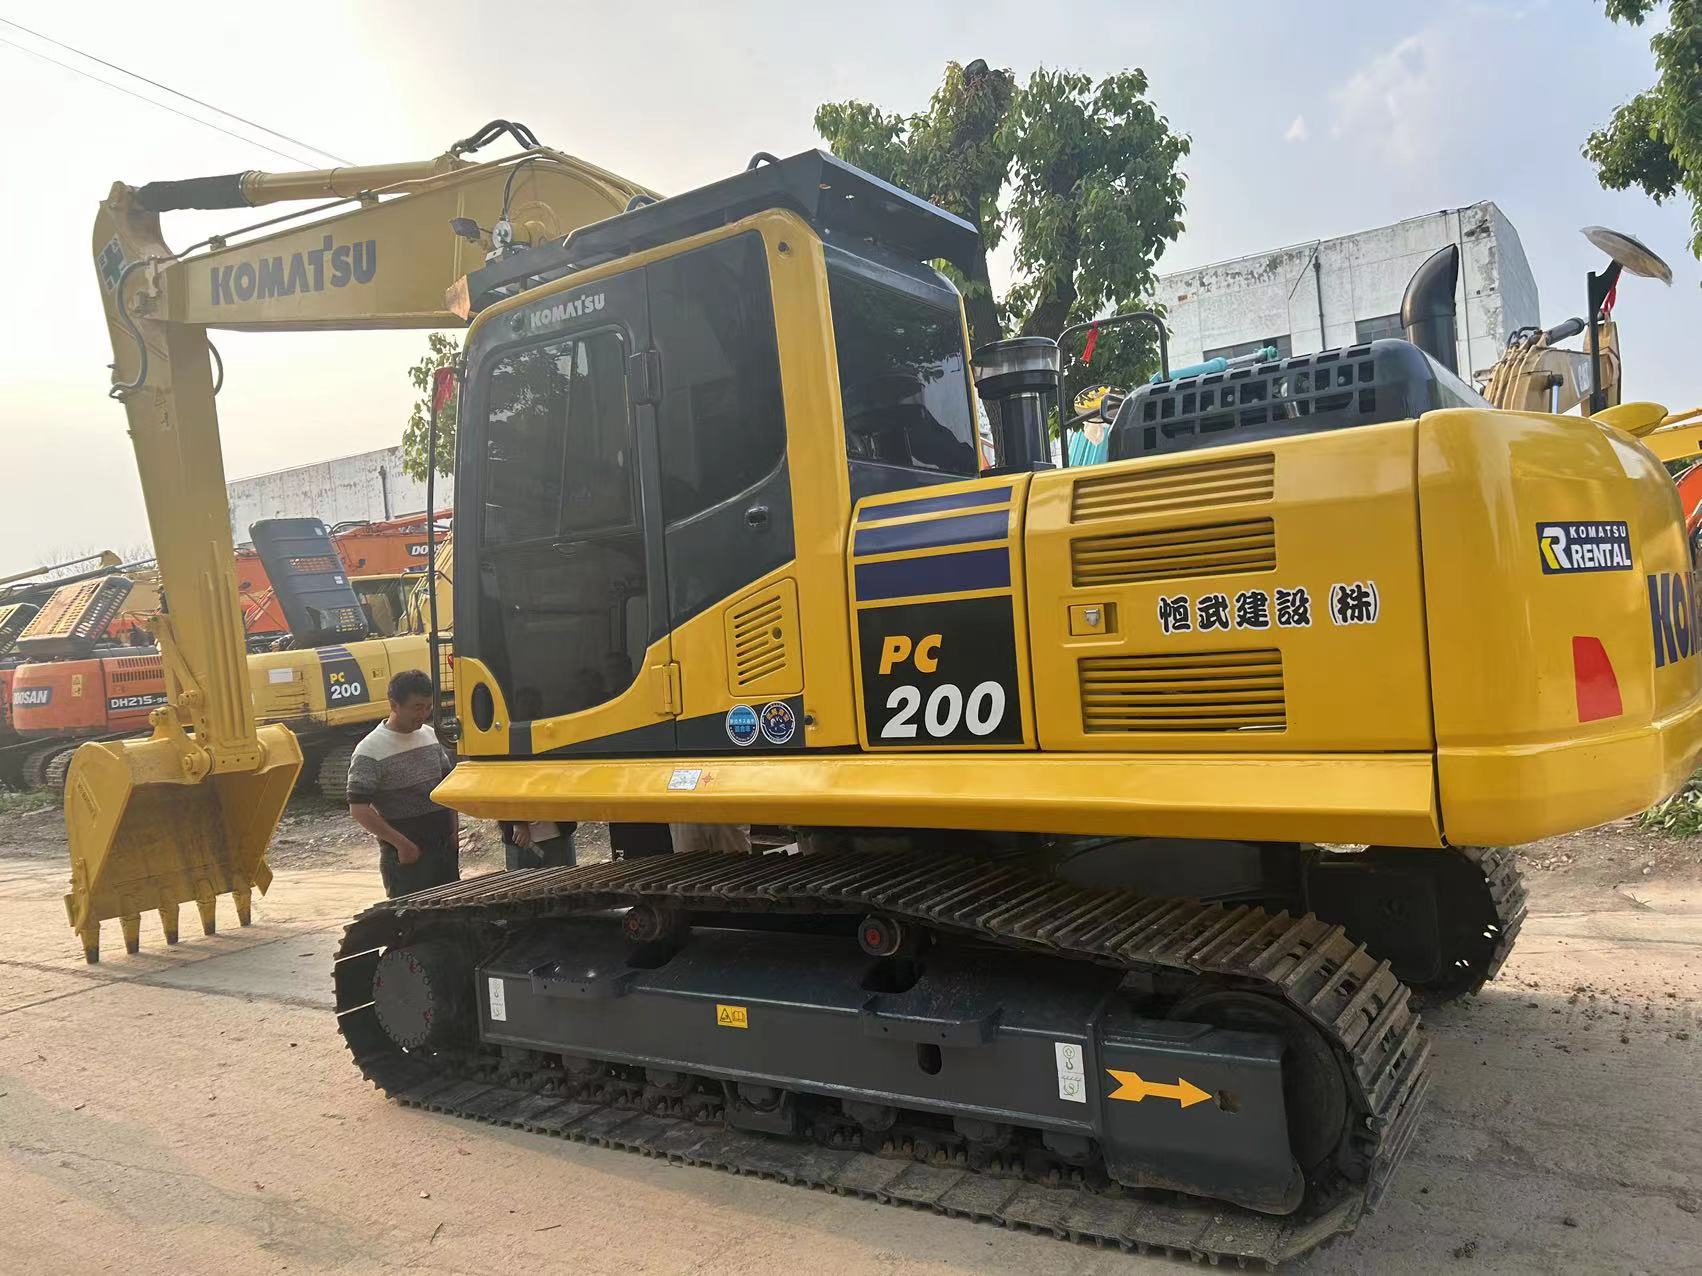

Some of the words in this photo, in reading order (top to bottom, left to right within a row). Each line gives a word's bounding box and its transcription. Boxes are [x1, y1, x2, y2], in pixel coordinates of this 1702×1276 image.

[210, 234, 377, 306] KOMATSU
[530, 293, 605, 330] KOMATSU
[1569, 526, 1627, 539] KOMATSU
[1570, 543, 1632, 569] RENTAL
[879, 633, 943, 675] PC
[329, 671, 345, 684] PC
[330, 682, 361, 700] 200
[880, 680, 1006, 739] 200
